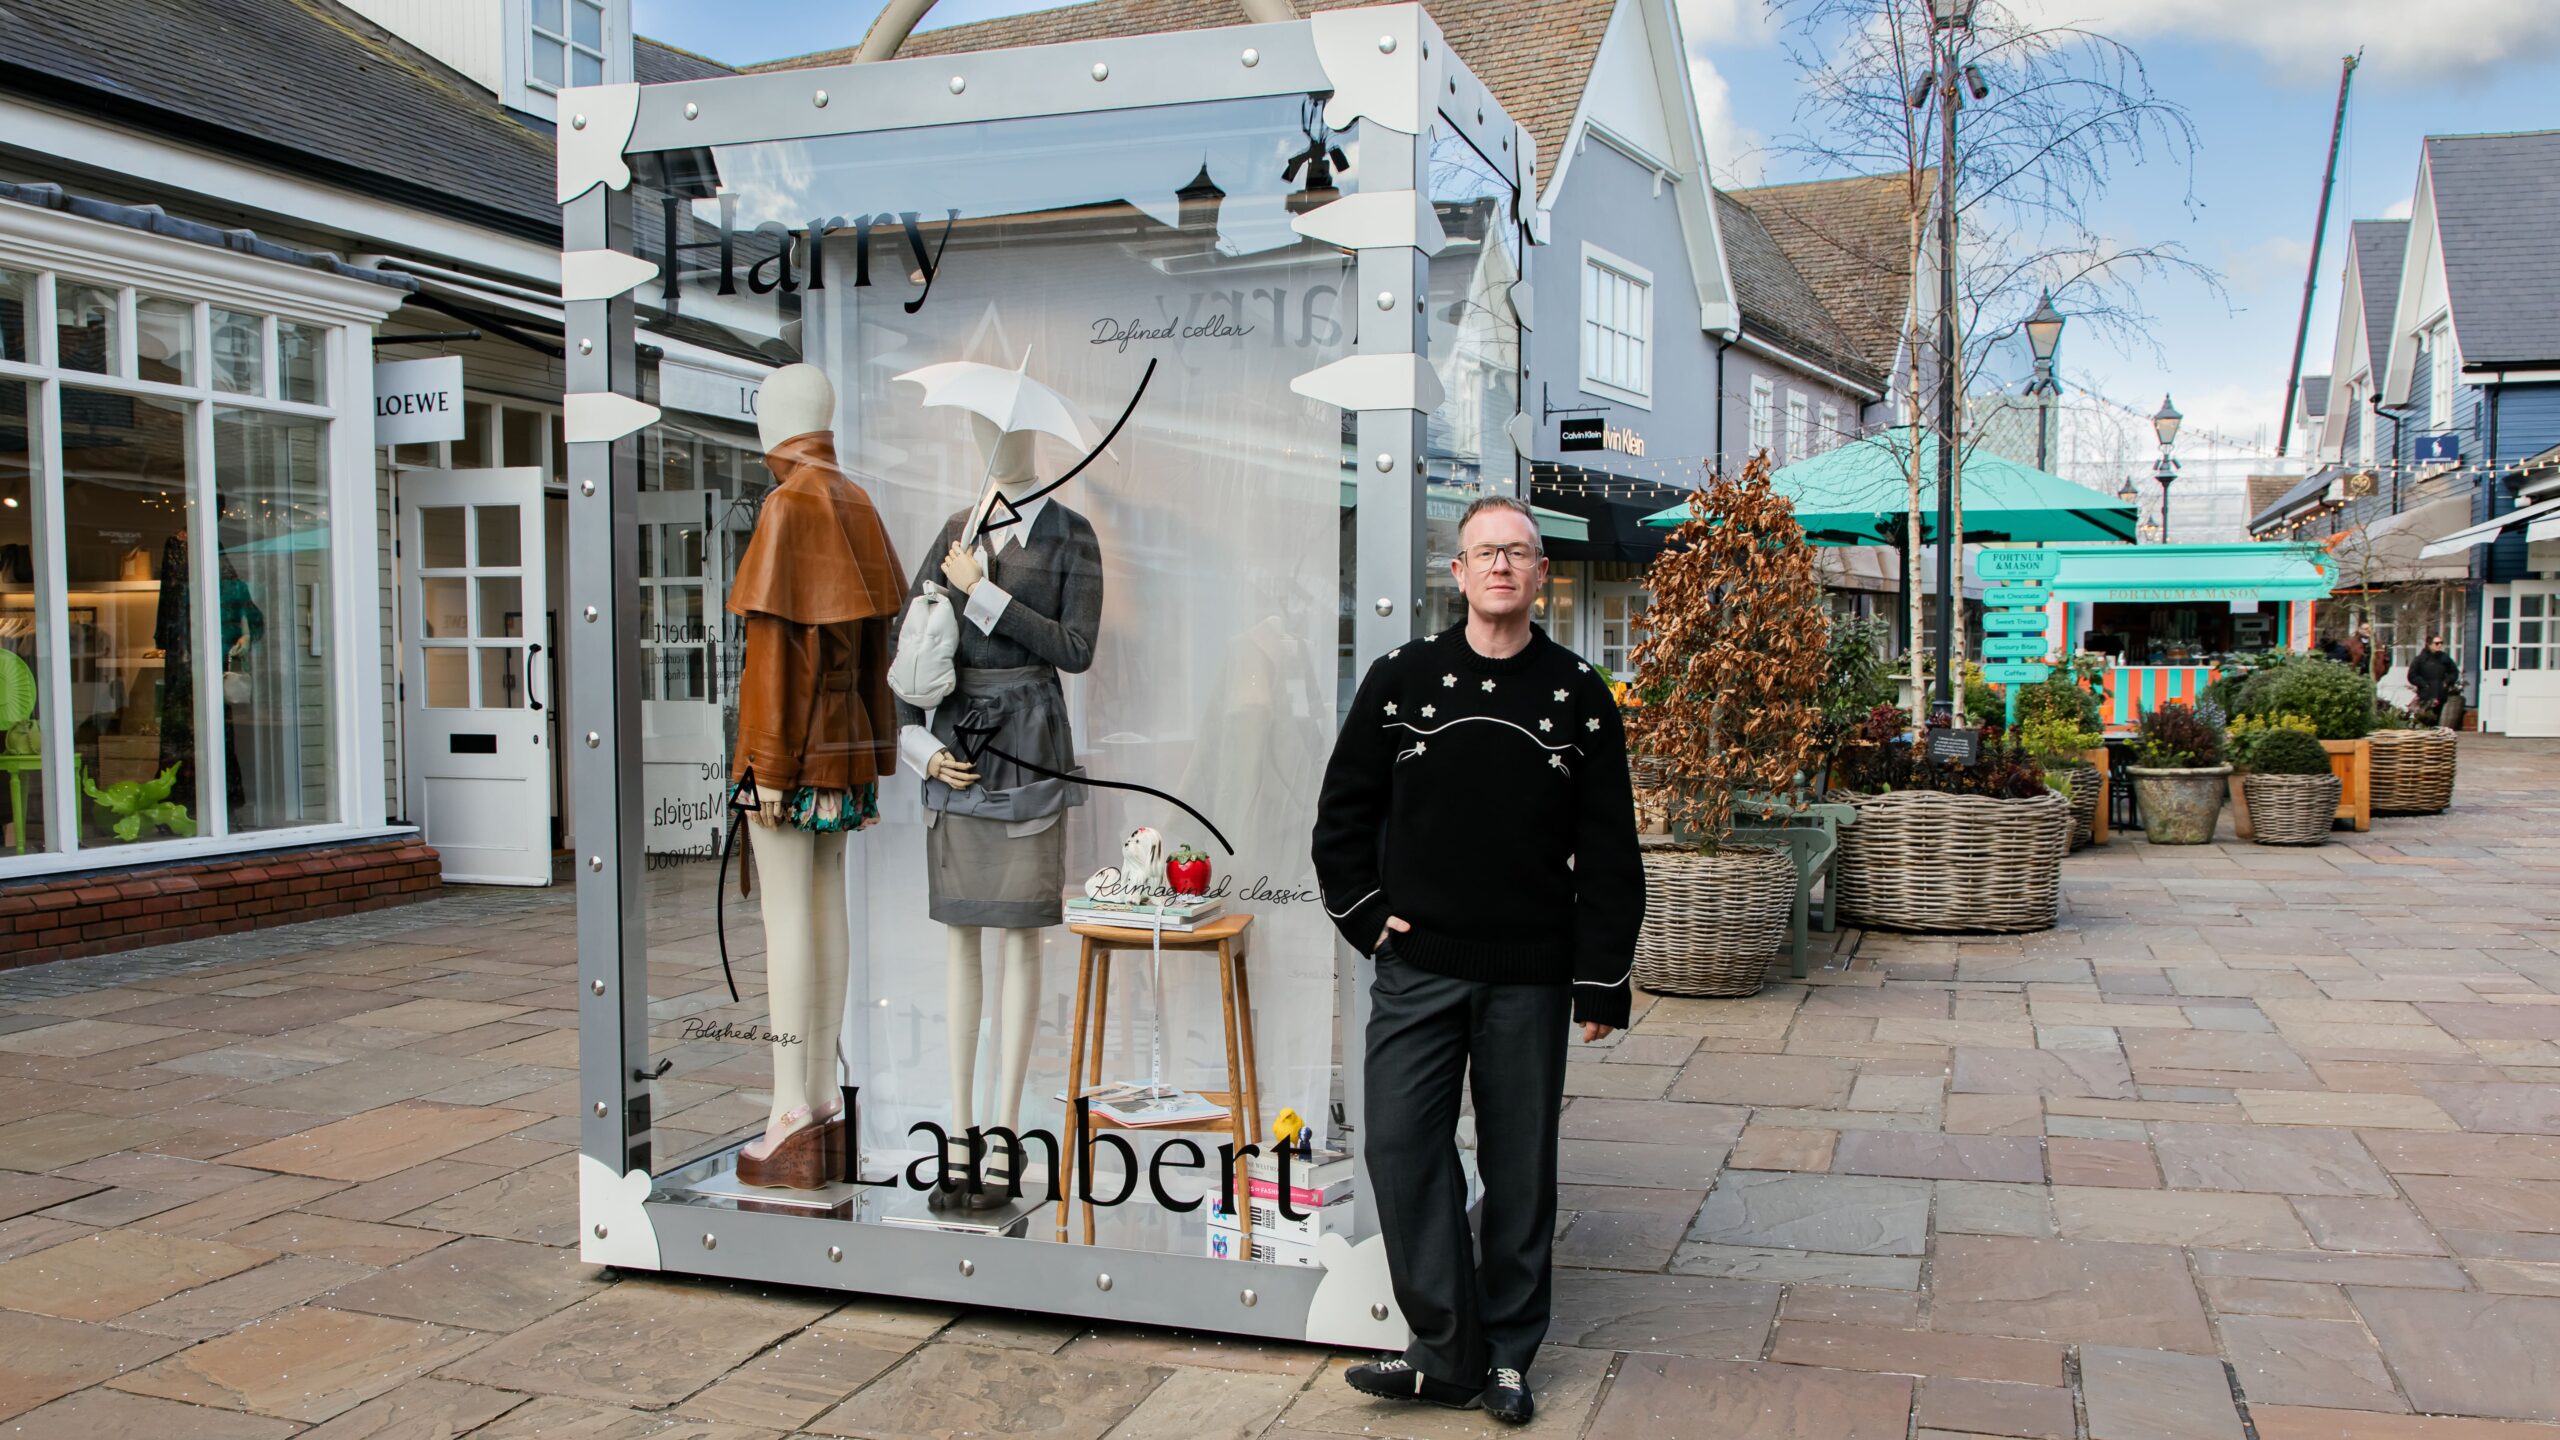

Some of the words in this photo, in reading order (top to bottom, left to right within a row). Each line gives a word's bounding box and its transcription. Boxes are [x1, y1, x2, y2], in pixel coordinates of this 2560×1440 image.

[660, 193, 961, 314] Harry
[1090, 315, 1179, 353] Defined
[1182, 314, 1255, 340] collar
[376, 391, 449, 417] LOEWE
[1562, 432, 1585, 440] Calvin
[1585, 430, 1602, 439] Klein
[1603, 422, 1621, 452] lvin
[1622, 428, 1645, 457] Klein
[1993, 553, 2043, 562] FORTNUM
[2108, 588, 2186, 600] FORTNUM
[2205, 588, 2261, 599] MASON
[1090, 867, 1231, 907] Reimagined
[1239, 875, 1323, 905] classic
[681, 1017, 758, 1042] Polished
[762, 1032, 803, 1047] ease
[839, 1084, 1312, 1222] Lambert
